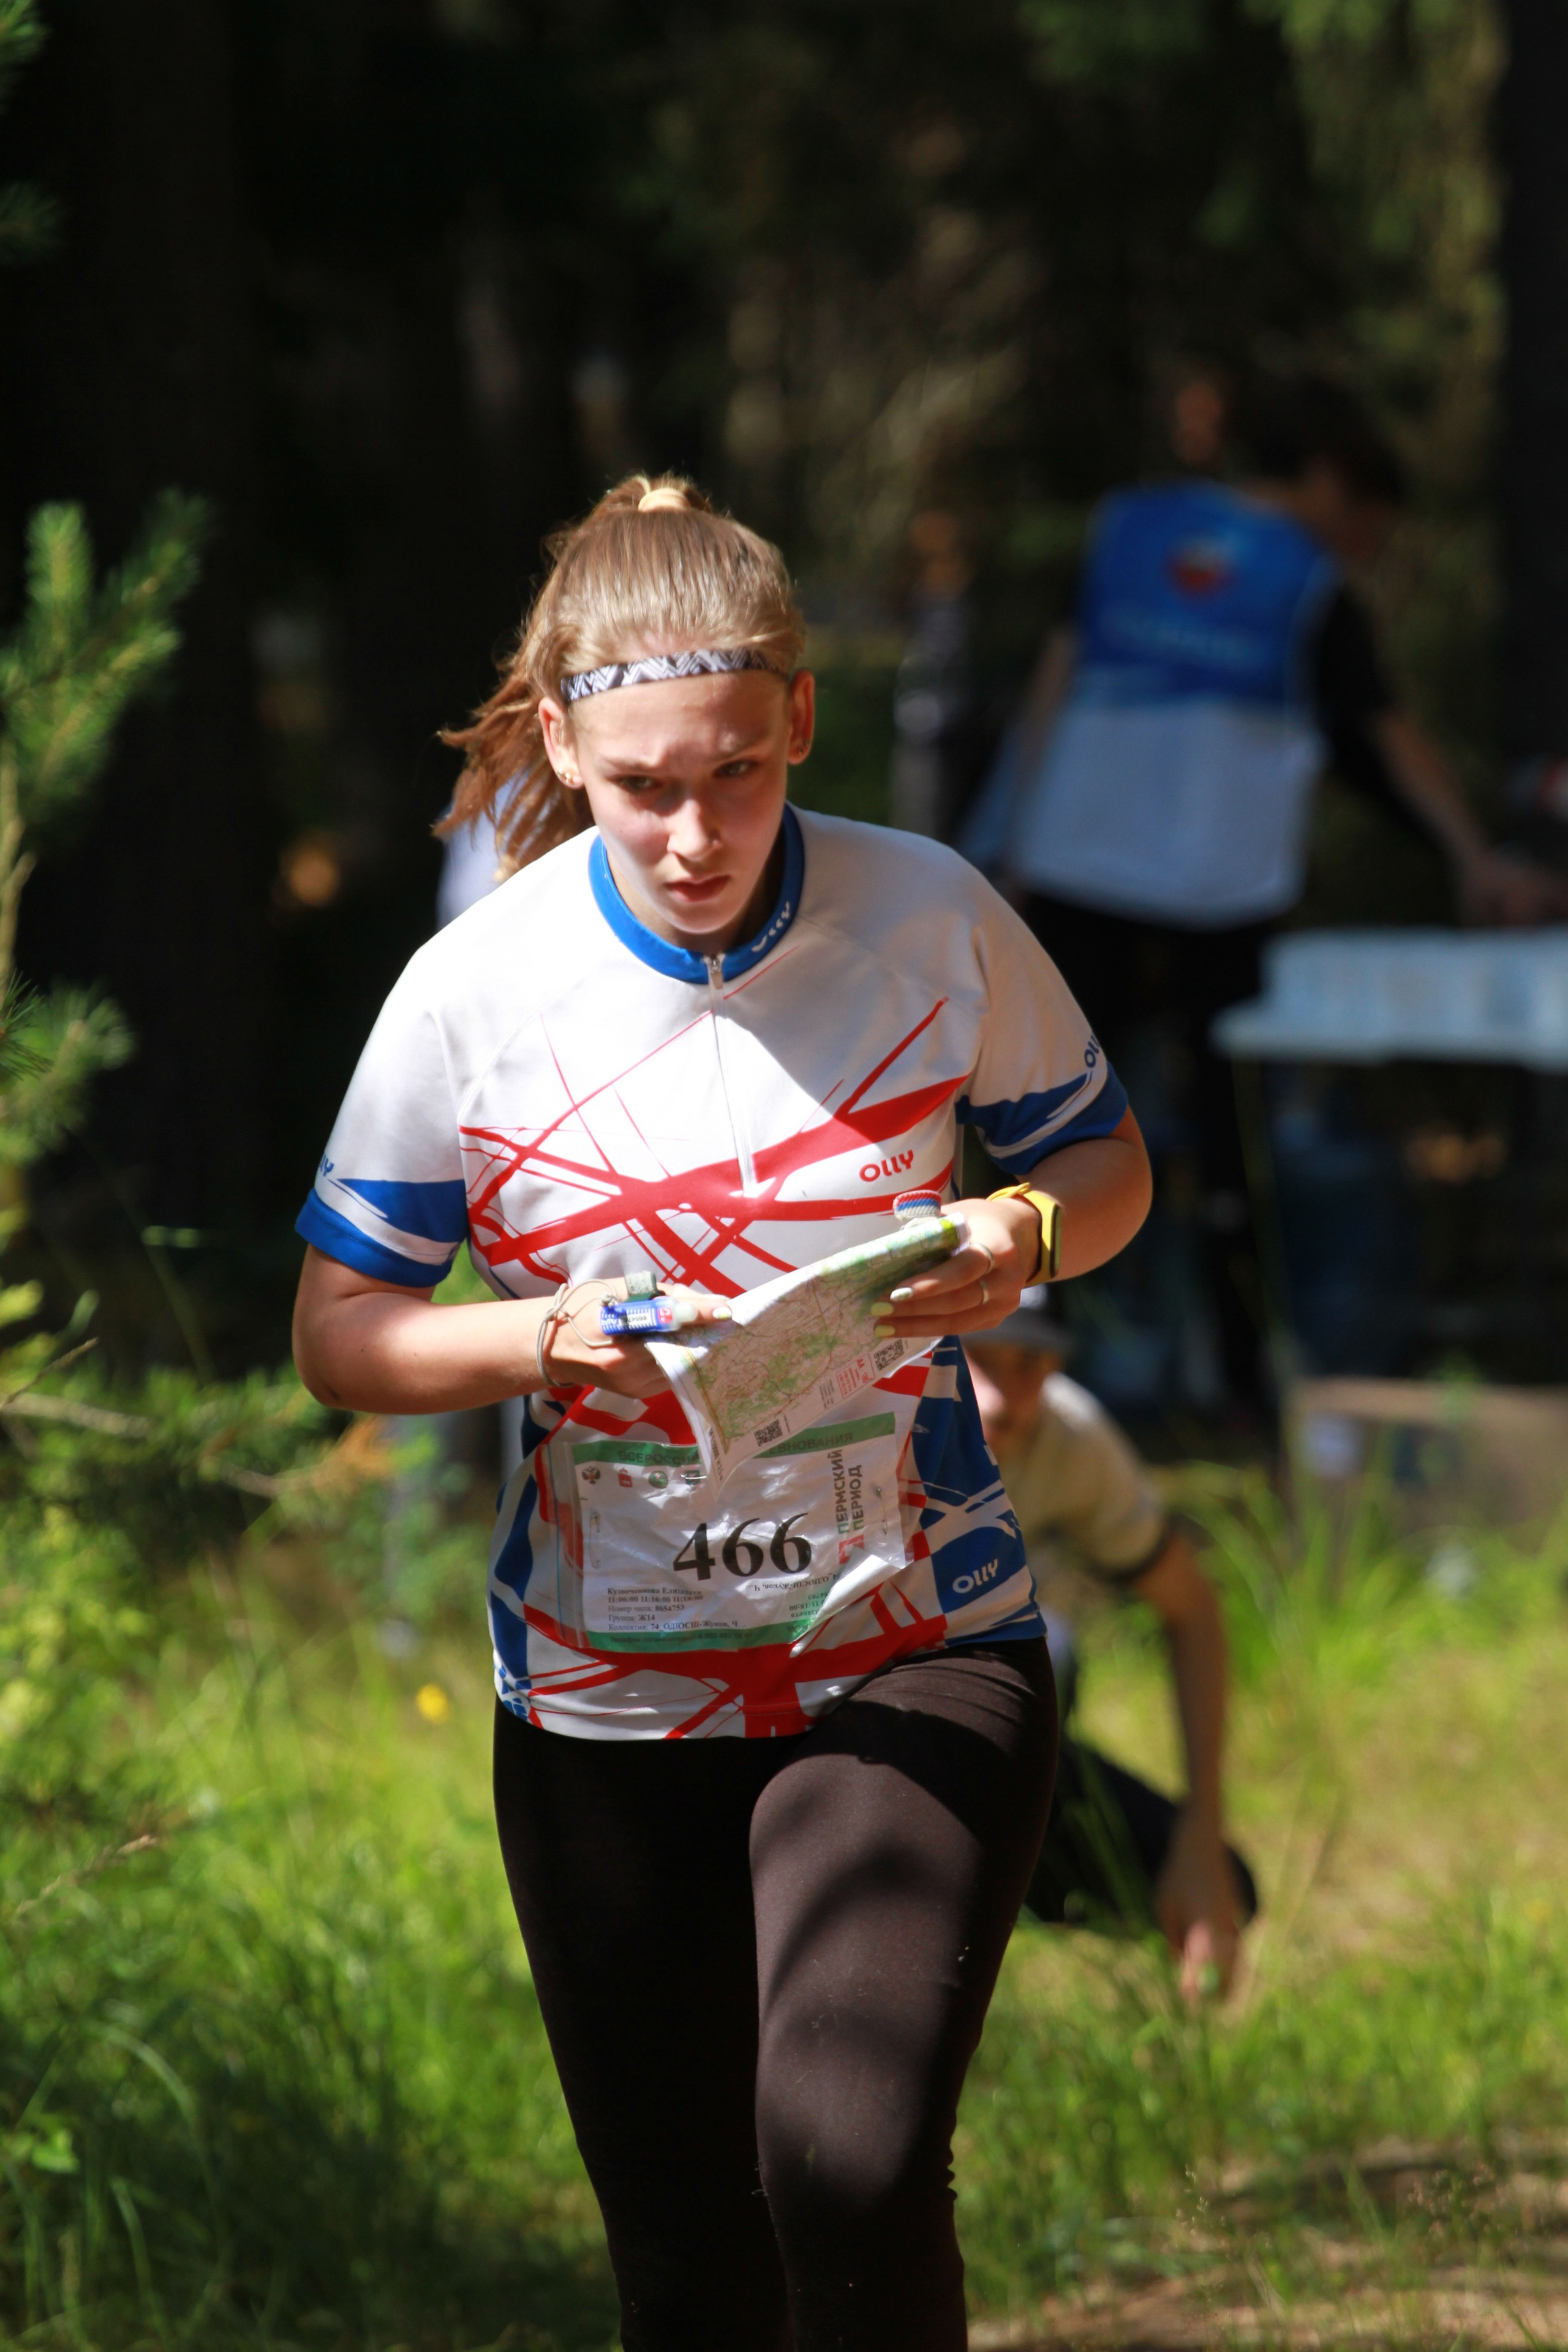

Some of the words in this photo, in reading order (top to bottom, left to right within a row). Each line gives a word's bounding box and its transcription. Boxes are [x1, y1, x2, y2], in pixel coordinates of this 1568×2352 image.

[859, 1149, 913, 1182] OLLY
[827, 1450, 850, 1534] ПЕРМСКИЙ
[848, 1464, 864, 1531] ПЕРИОД
[673, 1512, 812, 1581] 466
[952, 1558, 998, 1593] OLLY
